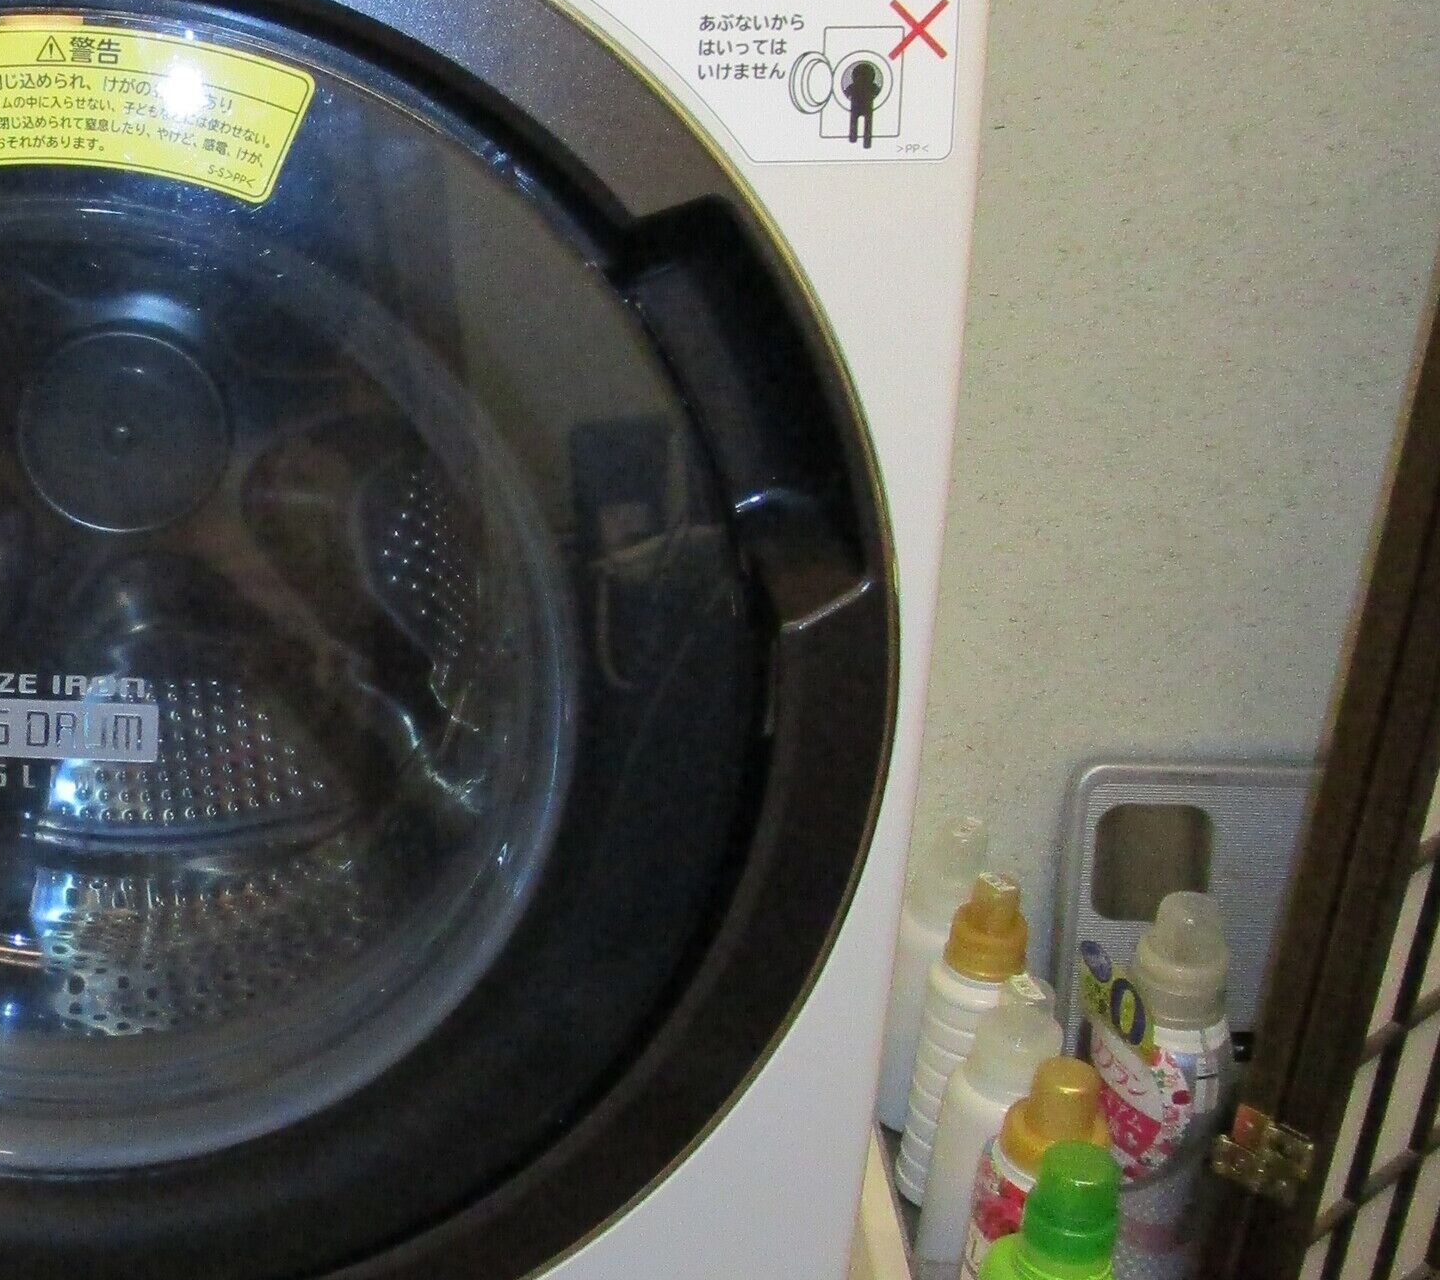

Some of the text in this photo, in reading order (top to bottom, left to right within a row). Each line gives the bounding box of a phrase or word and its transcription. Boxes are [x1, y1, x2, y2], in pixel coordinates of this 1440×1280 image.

[698, 13, 806, 32] あぶないから
[69, 35, 123, 65] 警告
[697, 38, 788, 56] はいっては
[697, 62, 787, 81] いけません
